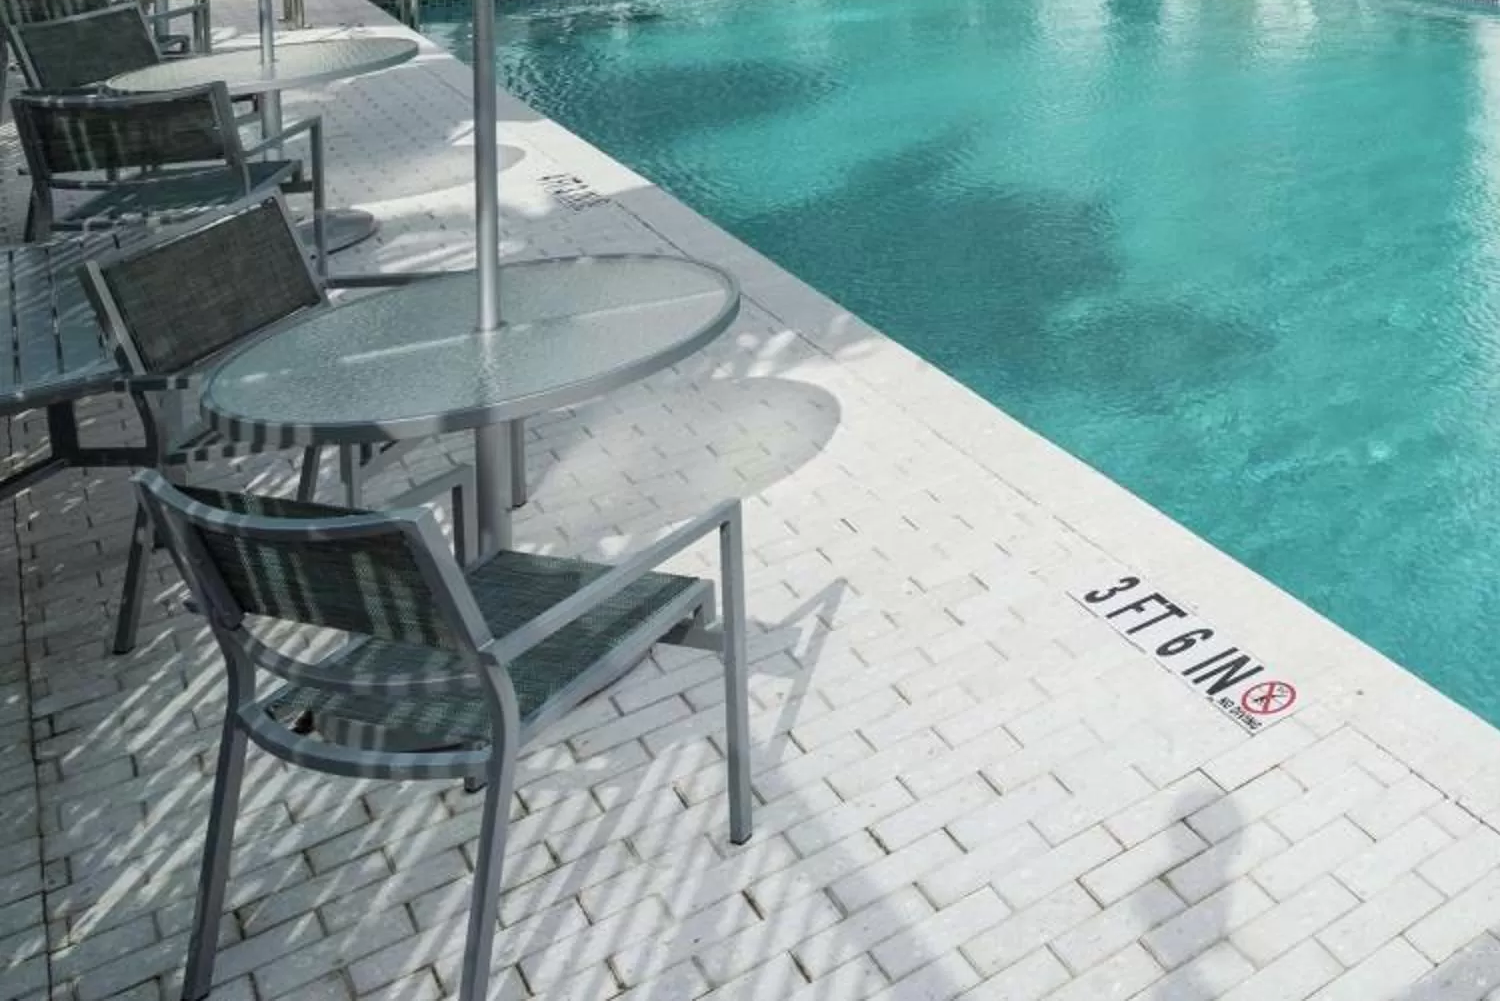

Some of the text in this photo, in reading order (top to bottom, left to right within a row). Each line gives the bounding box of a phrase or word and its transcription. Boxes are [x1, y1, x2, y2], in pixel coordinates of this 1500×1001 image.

[1083, 575, 1265, 696] 3 FT 6 IN
